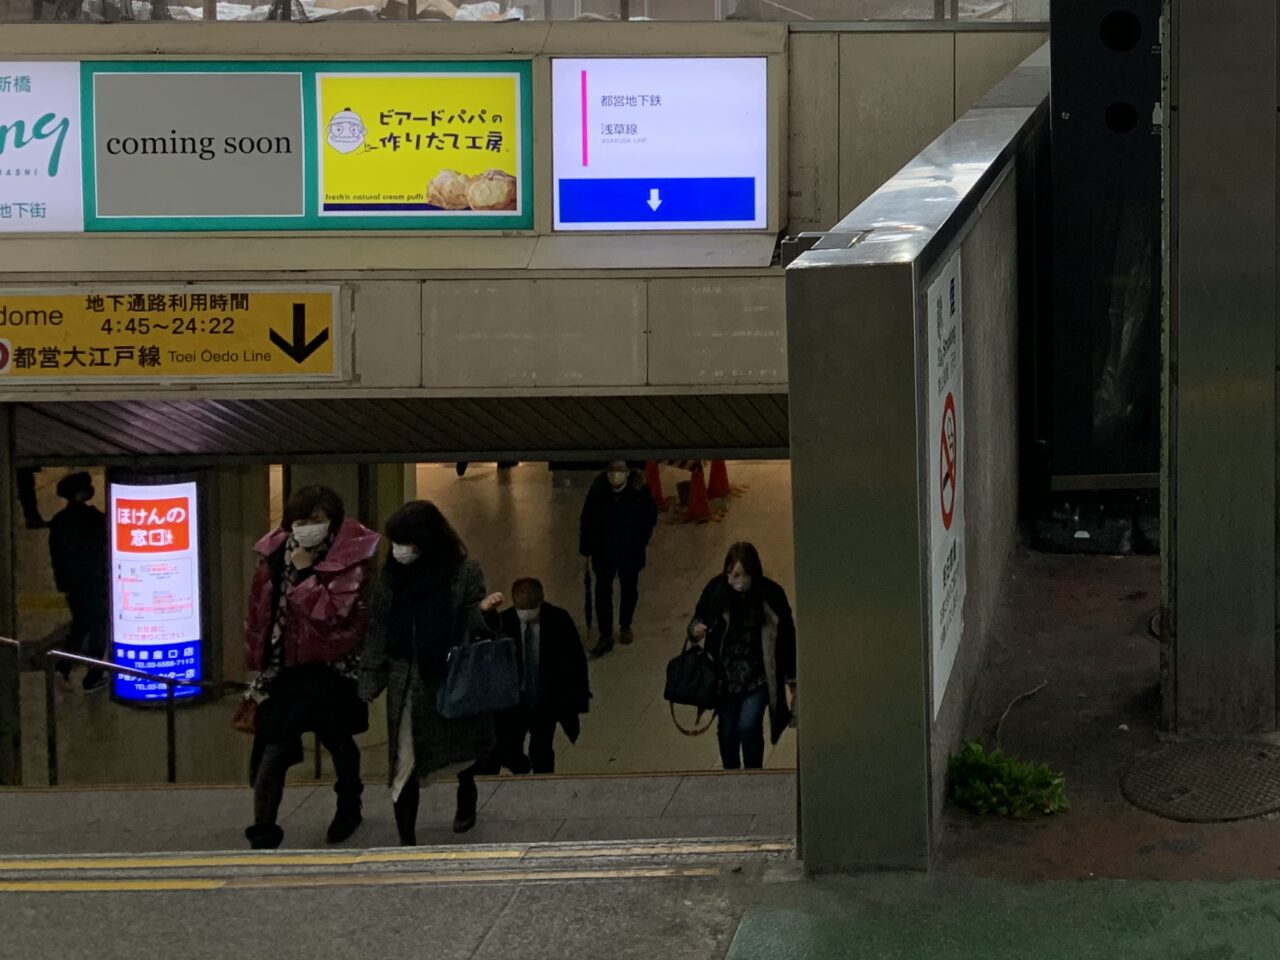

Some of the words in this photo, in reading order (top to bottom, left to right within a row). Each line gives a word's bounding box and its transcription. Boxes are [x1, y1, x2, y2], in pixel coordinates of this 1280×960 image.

[600, 94, 662, 107] 都営地下鉄
[379, 109, 503, 127] ビアードパパの
[600, 123, 638, 136] 浅草線
[106, 129, 216, 161] coming
[223, 136, 293, 155] soon
[379, 132, 503, 153] 作りたて工房
[0, 168, 38, 177] ASHI
[352, 193, 381, 201] natural
[0, 202, 47, 220] 地下街
[85, 293, 250, 313] 地下通路利用時間
[13, 345, 162, 369] 都営大江戸線
[168, 350, 196, 363] Toei
[243, 350, 272, 362] Line
[117, 507, 187, 526] ほけんの
[130, 528, 166, 547] 窓口
